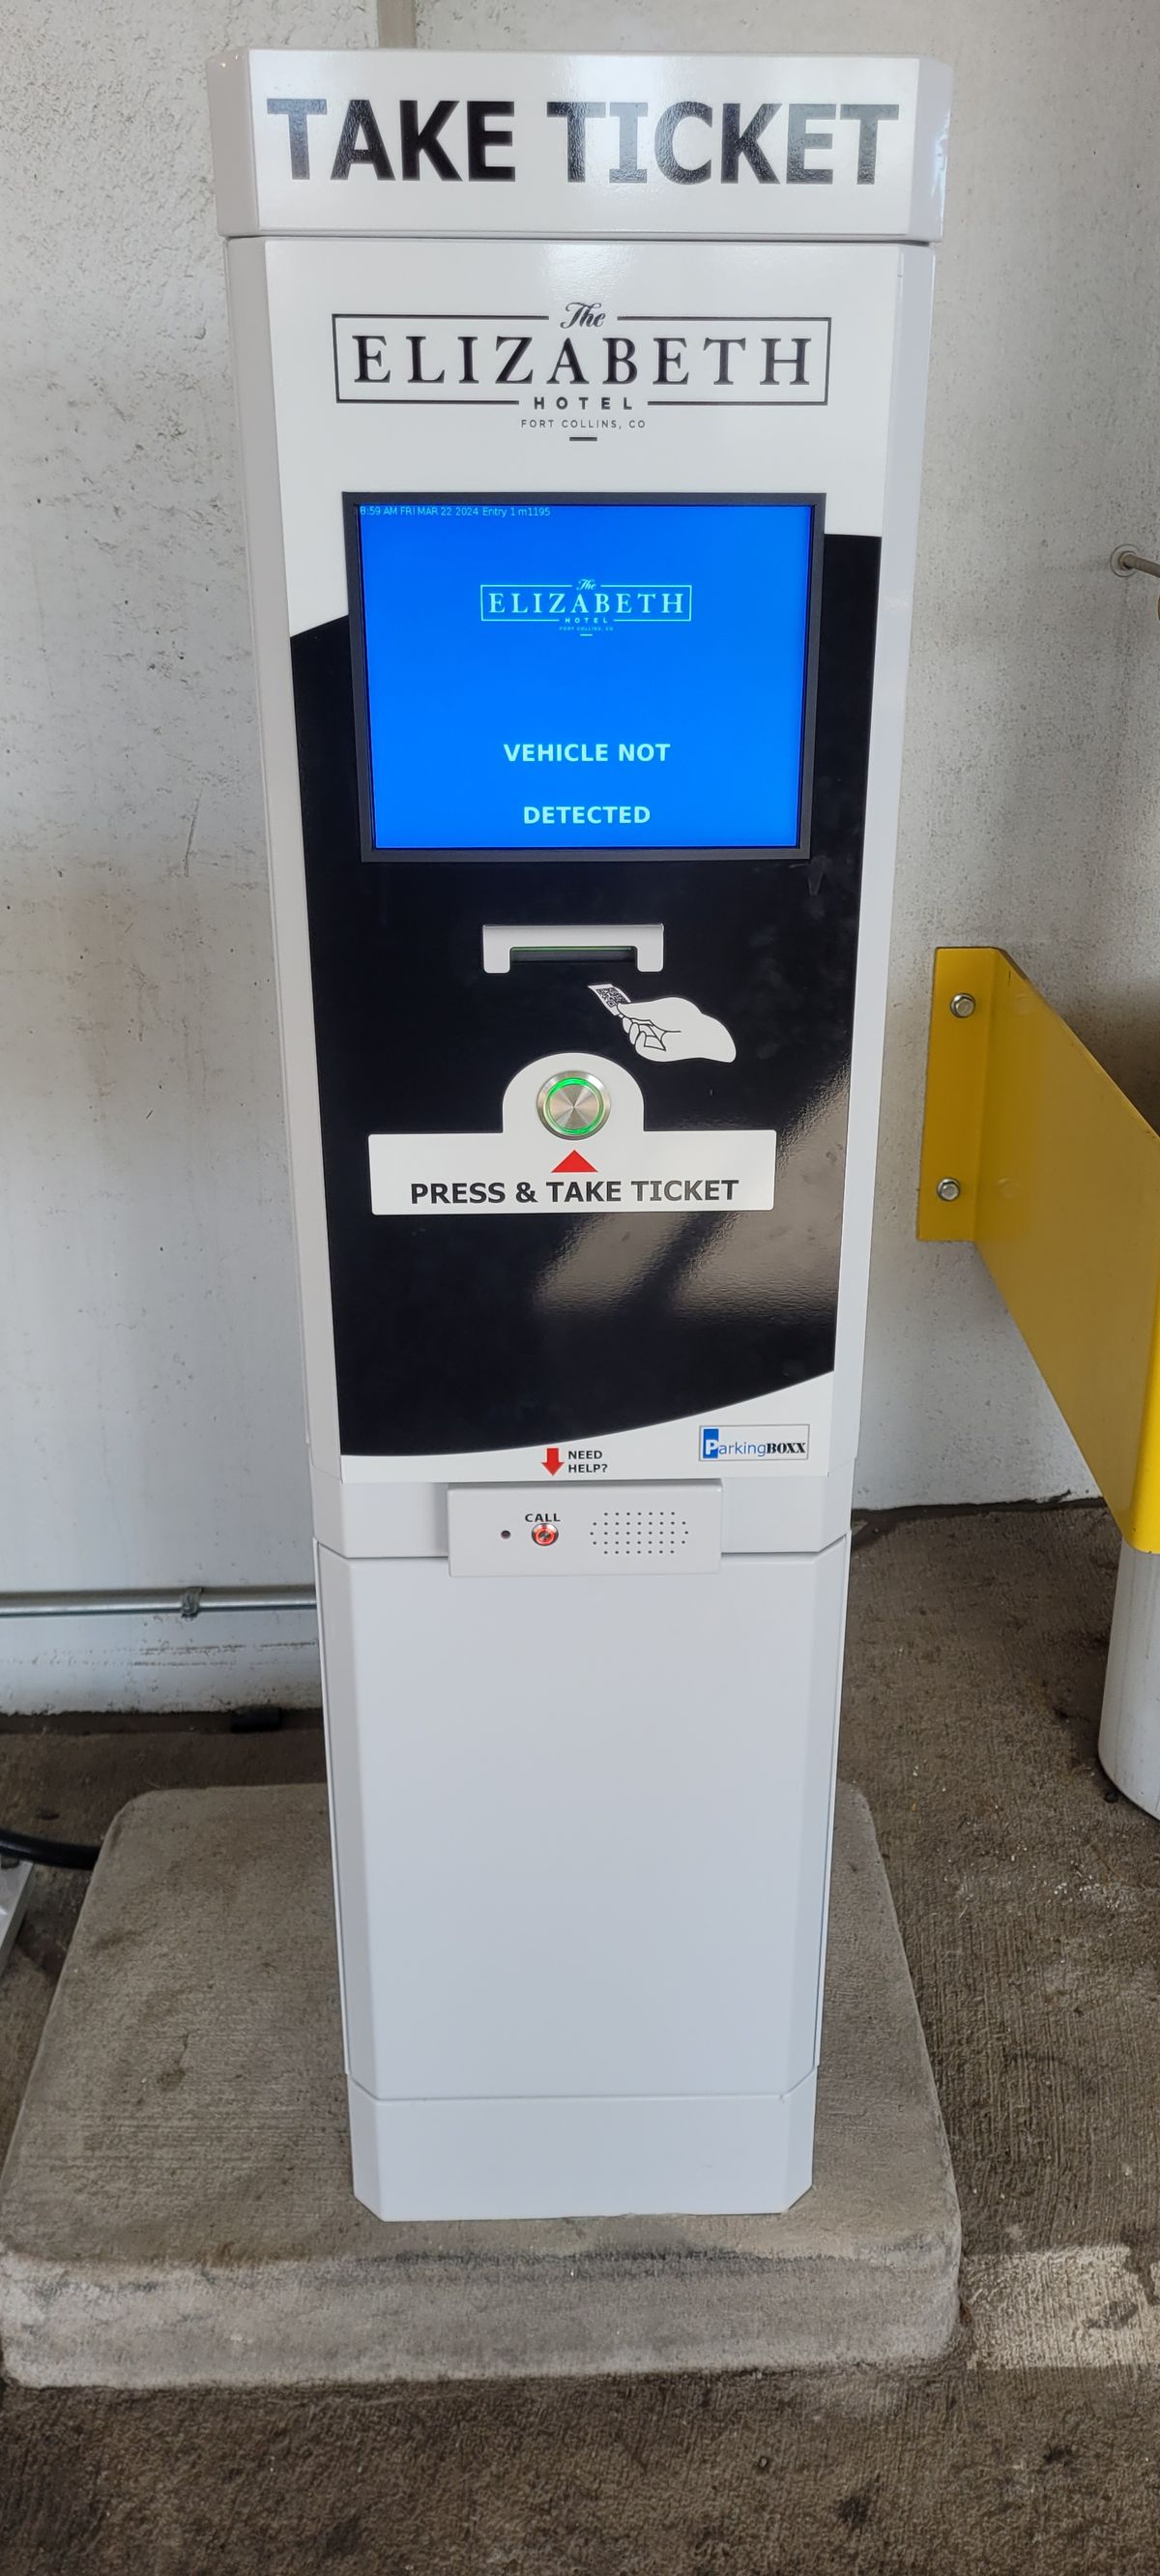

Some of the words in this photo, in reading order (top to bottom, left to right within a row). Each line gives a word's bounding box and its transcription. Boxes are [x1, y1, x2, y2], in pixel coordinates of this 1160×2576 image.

[266, 97, 517, 183] TAKE
[545, 101, 900, 186] TICKET
[560, 302, 607, 330] The
[352, 335, 813, 386] ELIZABETH
[533, 396, 633, 410] HOTEL
[520, 419, 556, 429] FORT
[561, 419, 624, 430] COLLINS,
[628, 419, 647, 429] CO
[384, 506, 398, 515] AM
[400, 507, 416, 515] FRI
[418, 507, 439, 515] MAR
[440, 507, 452, 516] 22
[455, 507, 479, 516] 2024
[482, 507, 508, 517] Entry
[517, 507, 551, 516] m1195
[576, 579, 596, 591] The
[488, 593, 684, 614] ELIZABETH
[503, 743, 609, 762] VEHICLE
[618, 743, 672, 762] NOT
[523, 805, 651, 824] DETECTED
[410, 1182, 506, 1205] PRESS
[515, 1181, 539, 1204] &
[545, 1181, 623, 1203] TAKE
[630, 1179, 740, 1202] TICKET
[567, 1449, 603, 1460] NEED
[567, 1463, 609, 1474] HELP?
[524, 1513, 562, 1523] CALL
